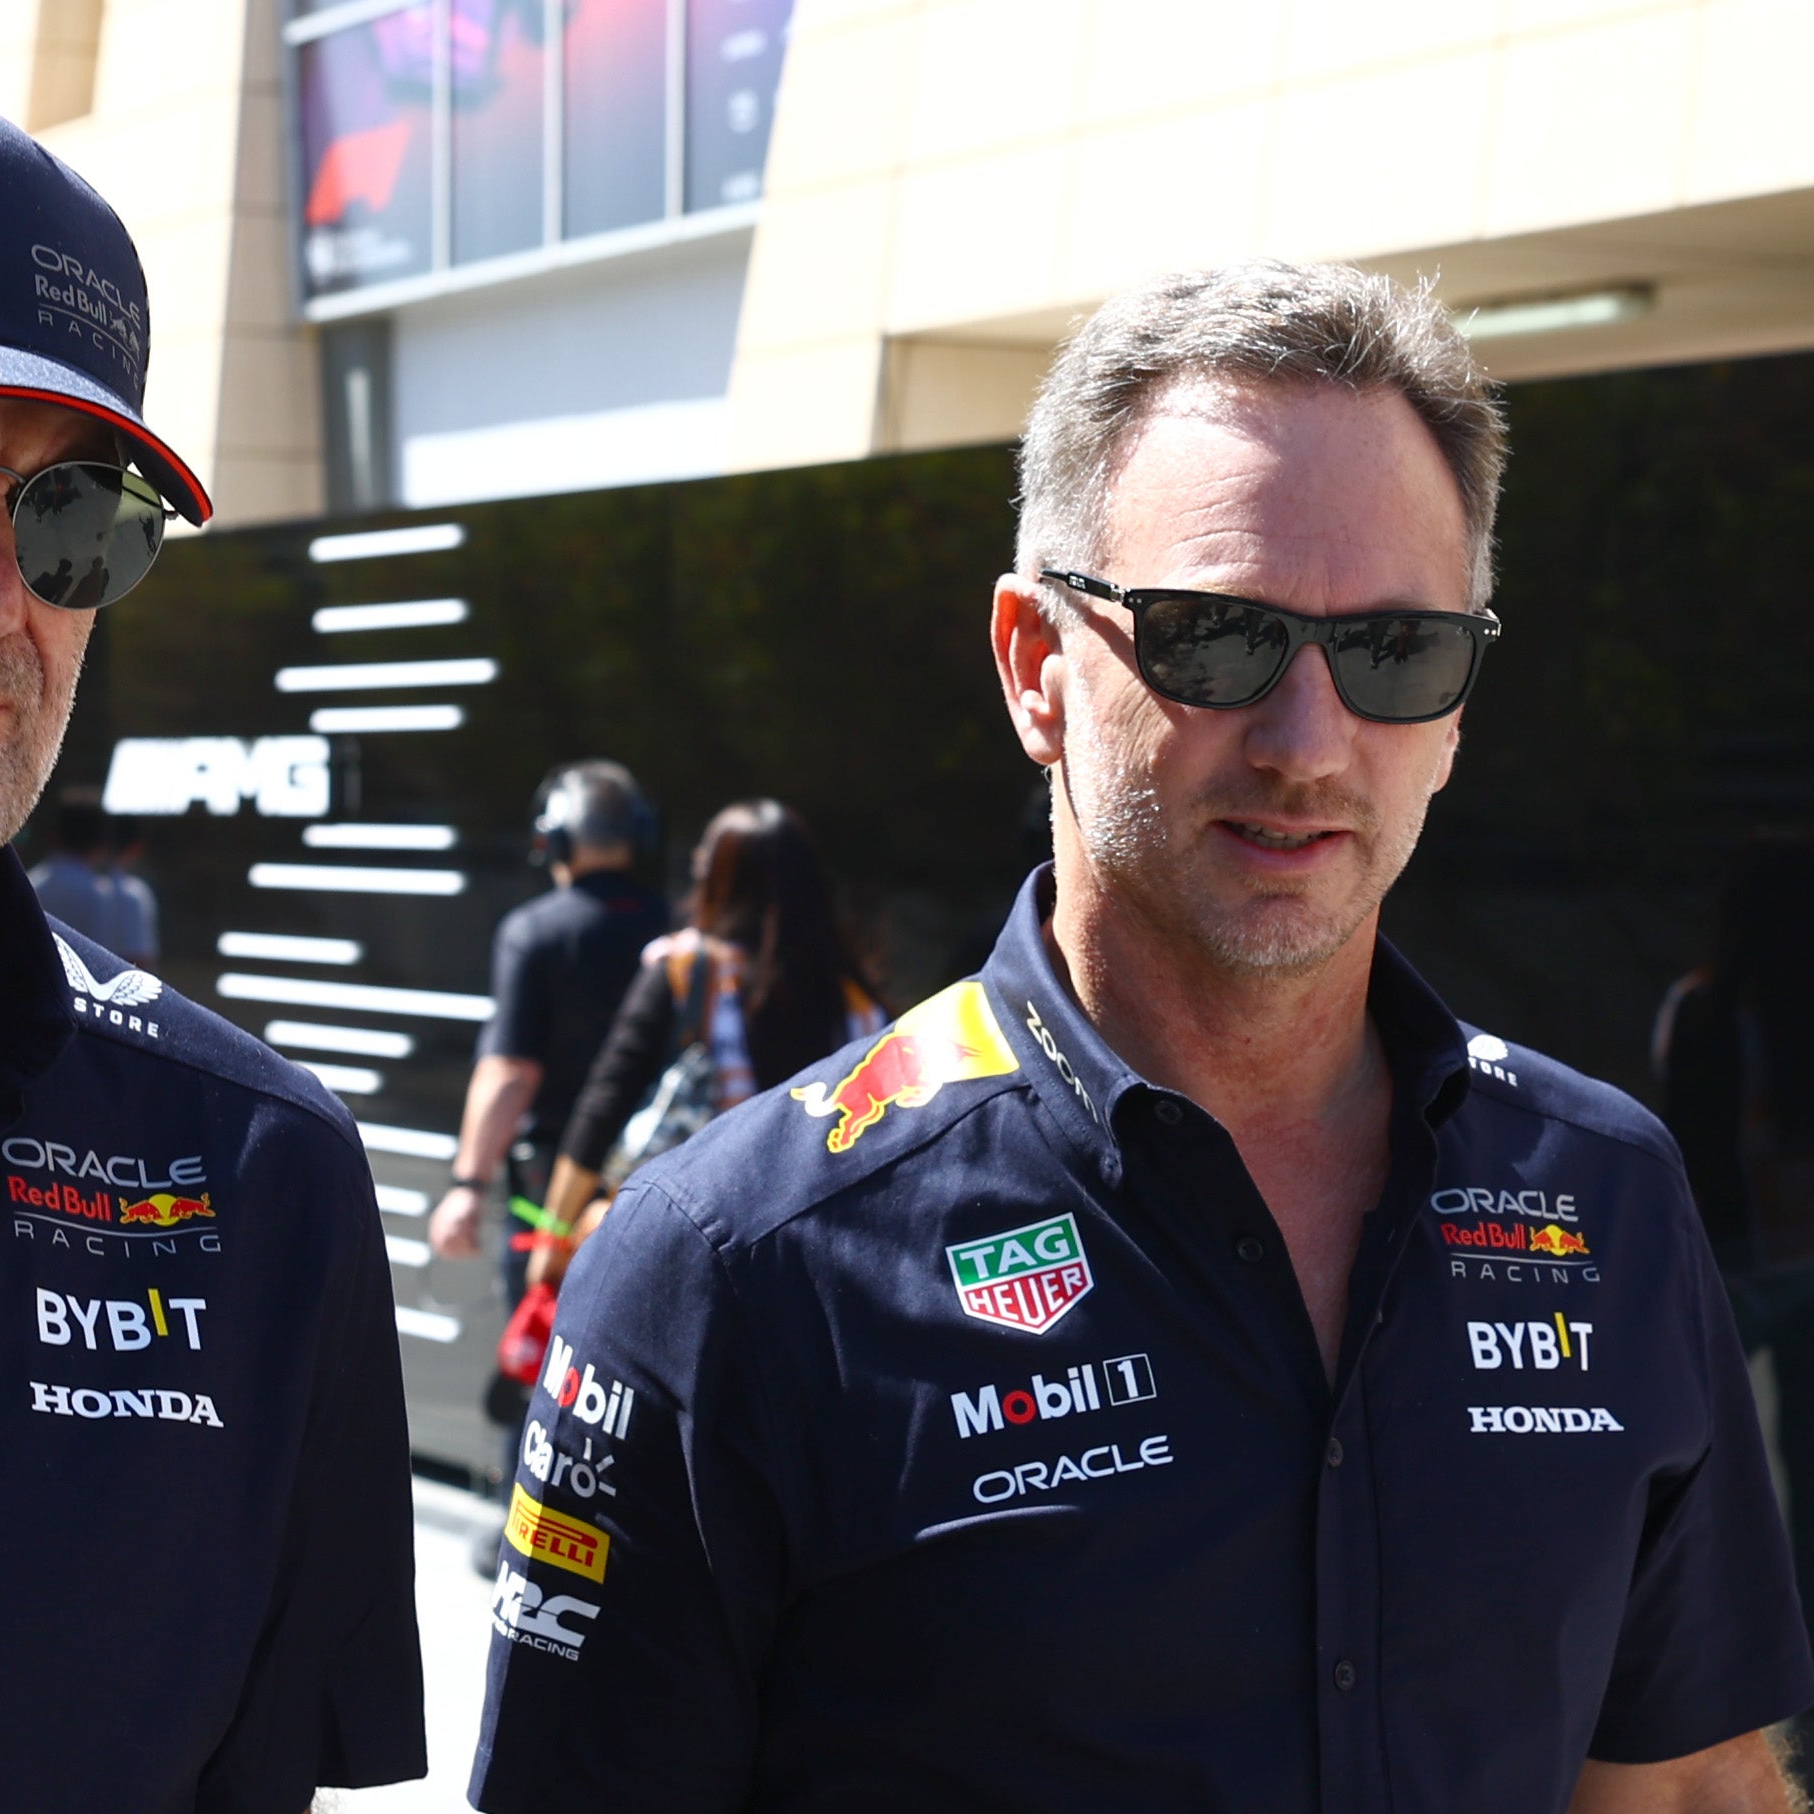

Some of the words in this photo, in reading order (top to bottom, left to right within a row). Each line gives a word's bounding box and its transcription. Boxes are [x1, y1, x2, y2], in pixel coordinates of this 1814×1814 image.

[31, 243, 141, 330] ORACLE
[1, 1137, 207, 1189] ORACLE
[1430, 1187, 1579, 1223] ORACLE
[13, 1219, 222, 1259] RACING
[959, 1225, 1071, 1280] TAG
[967, 1266, 1084, 1326] HEUER
[1450, 1260, 1601, 1284] RACING
[36, 1286, 207, 1352] BYBIT
[1467, 1311, 1593, 1371] BYBIT
[29, 1380, 225, 1428] HONDA
[543, 1334, 635, 1440] Mobil
[950, 1363, 1101, 1439] Mobil
[1467, 1406, 1625, 1434] HONDA
[523, 1419, 598, 1498] Claro
[973, 1434, 1174, 1504] ORACLE
[512, 1499, 599, 1568] PIRELLI
[508, 1627, 580, 1662] RACING
